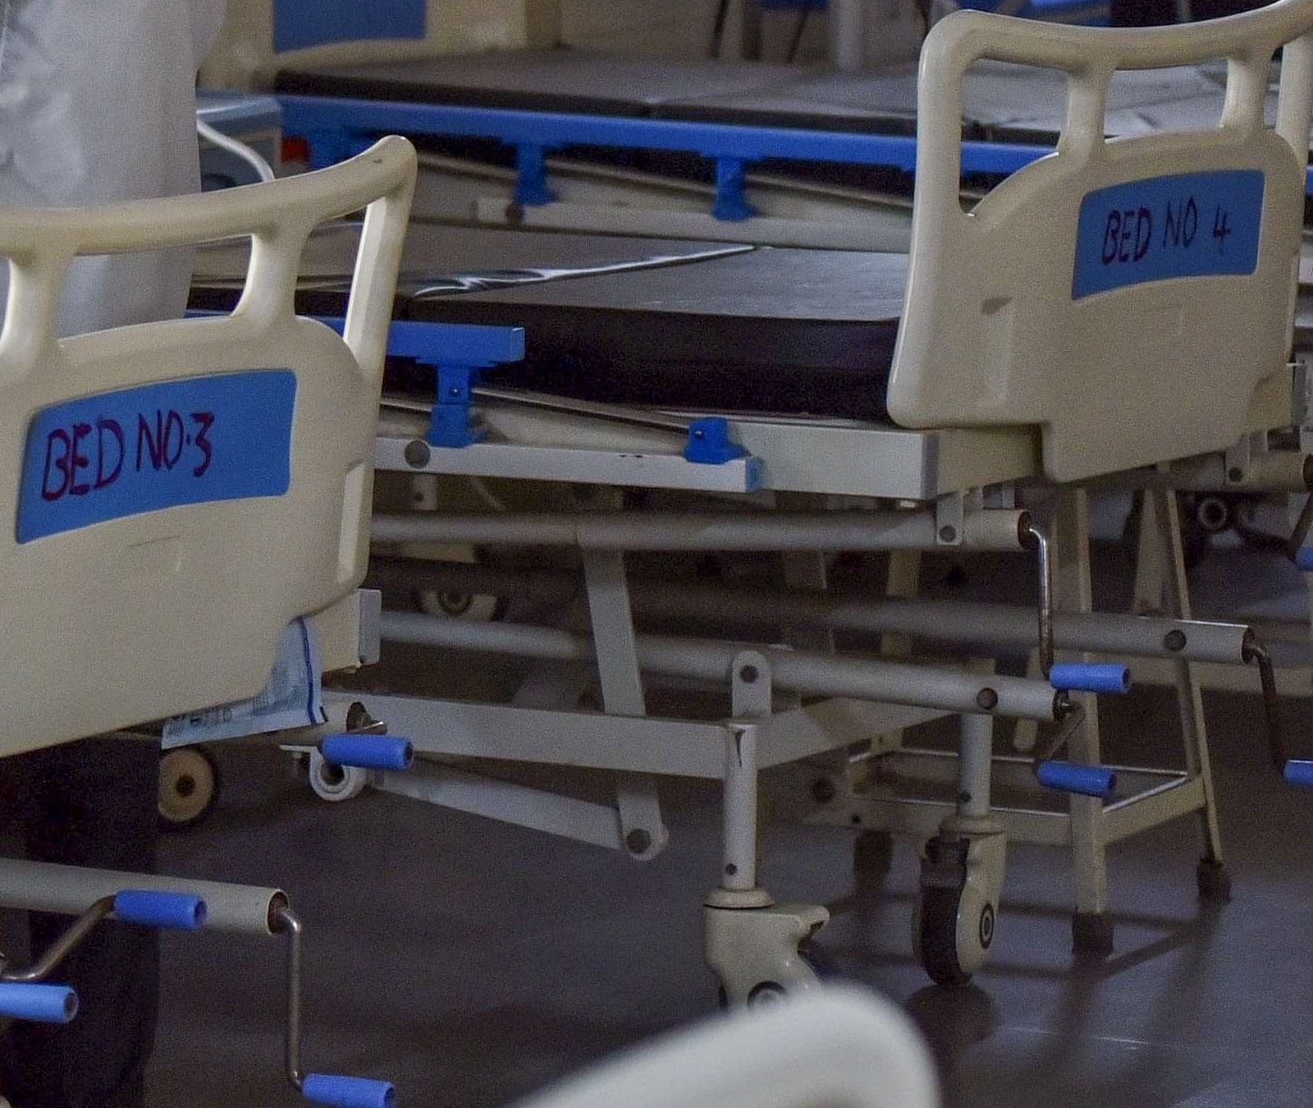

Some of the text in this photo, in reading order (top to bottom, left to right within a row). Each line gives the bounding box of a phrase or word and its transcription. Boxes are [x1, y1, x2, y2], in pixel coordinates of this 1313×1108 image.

[1101, 195, 1231, 266] BED NO 4
[41, 419, 125, 502] BED
